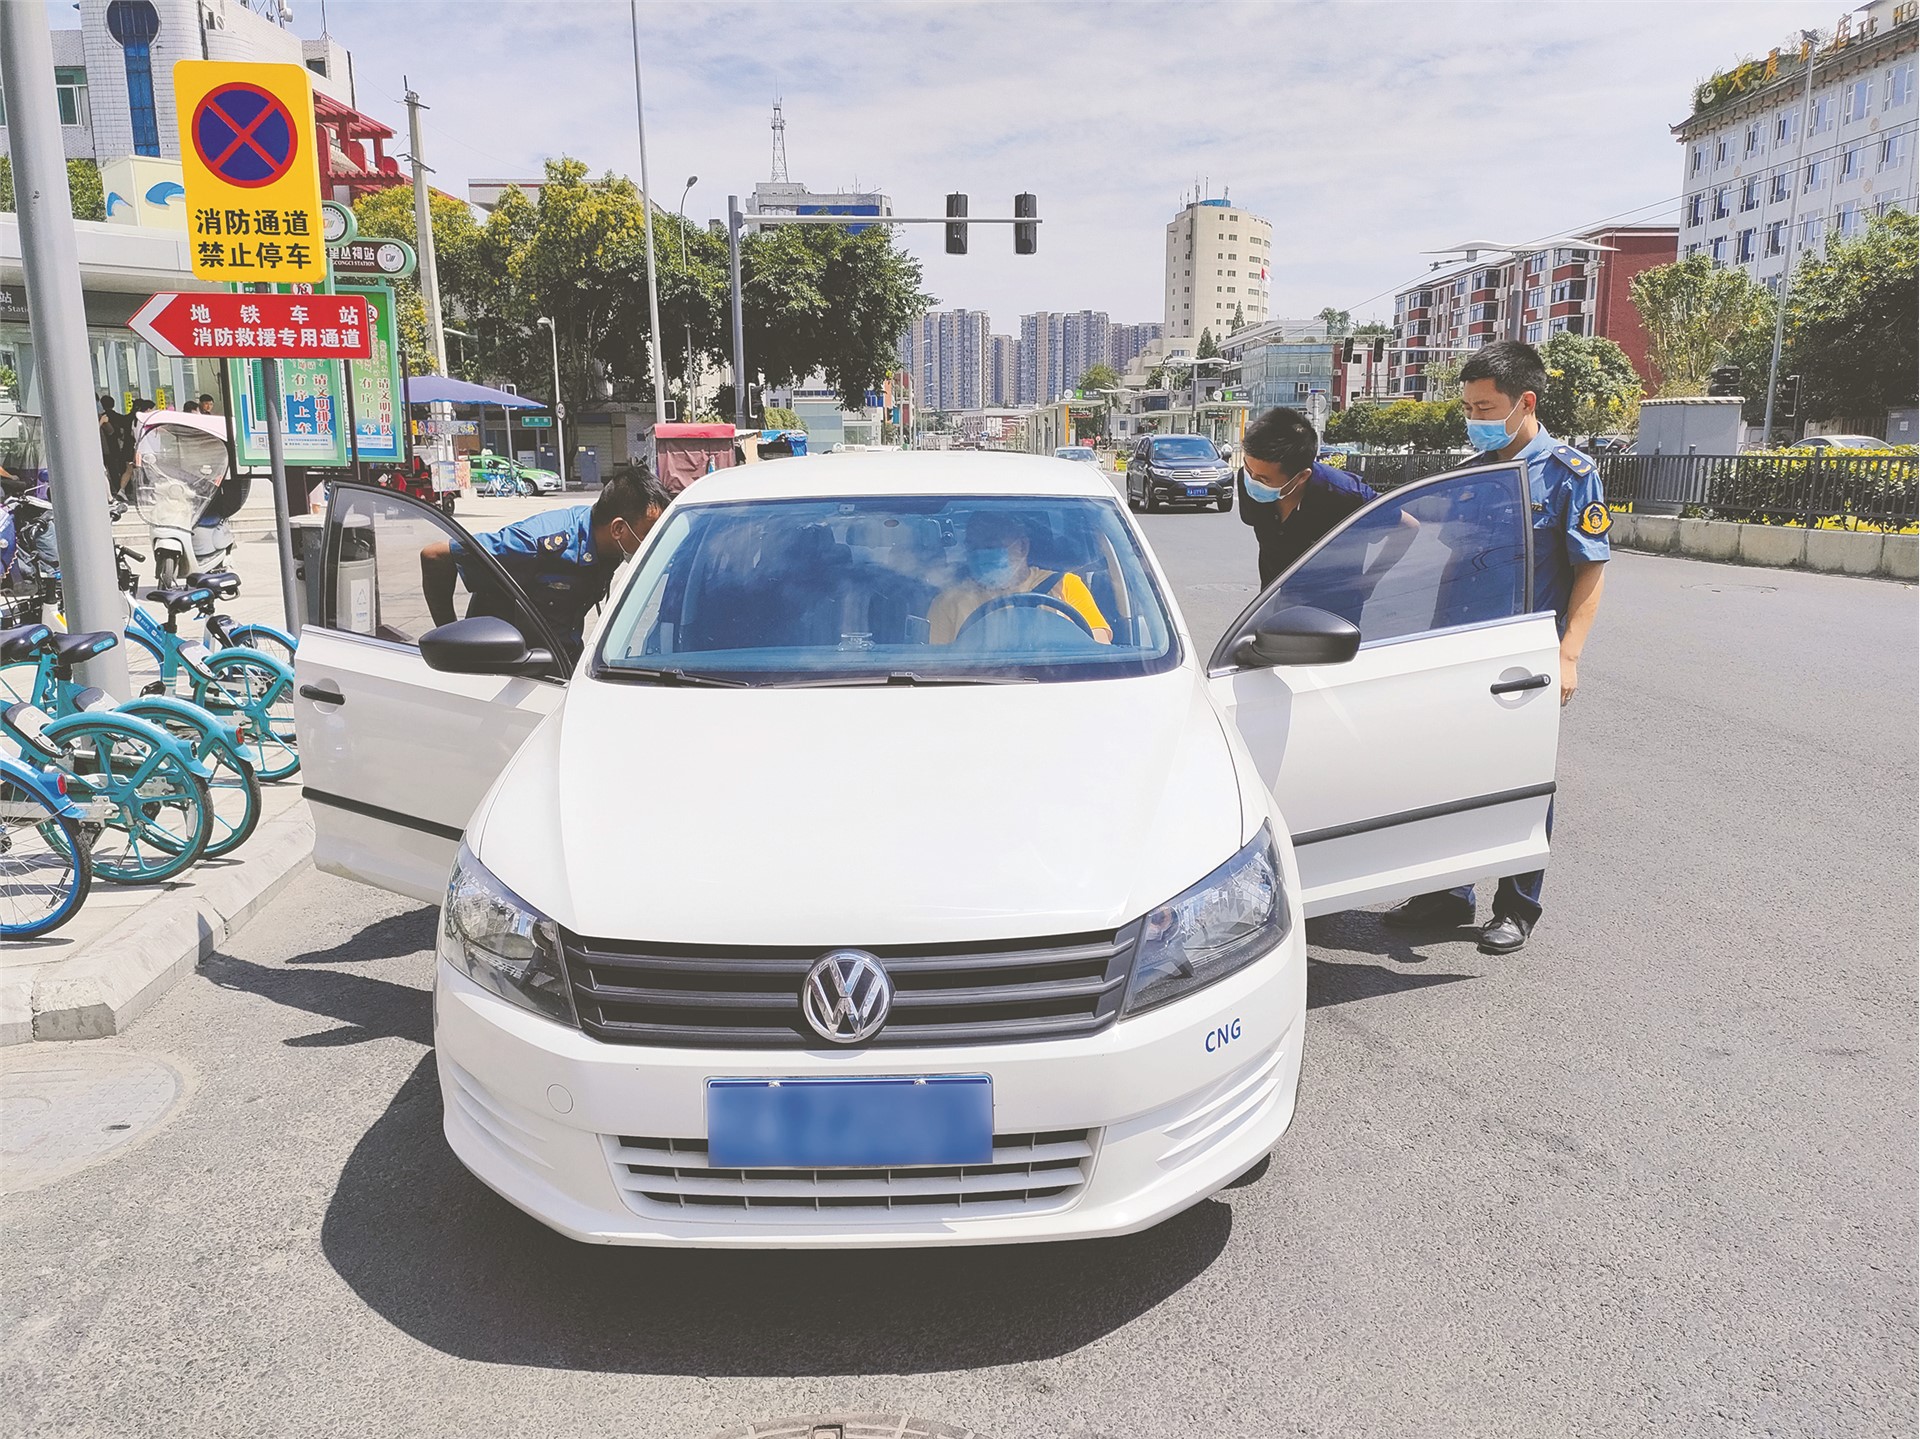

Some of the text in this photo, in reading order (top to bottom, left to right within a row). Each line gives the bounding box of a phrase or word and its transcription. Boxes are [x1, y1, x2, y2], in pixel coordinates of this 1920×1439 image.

[195, 208, 310, 236] 消防通道
[197, 241, 312, 269] 禁止停车
[325, 246, 375, 260] 望丛祠站
[190, 304, 359, 326] 地铁车站
[192, 327, 362, 348] 消防救援专用通道
[292, 374, 312, 435] 有序上车
[312, 374, 332, 435] 请文明排队
[360, 378, 376, 436] 有序上车
[377, 378, 393, 436] 请文明排队
[1205, 1017, 1241, 1053] CNG
